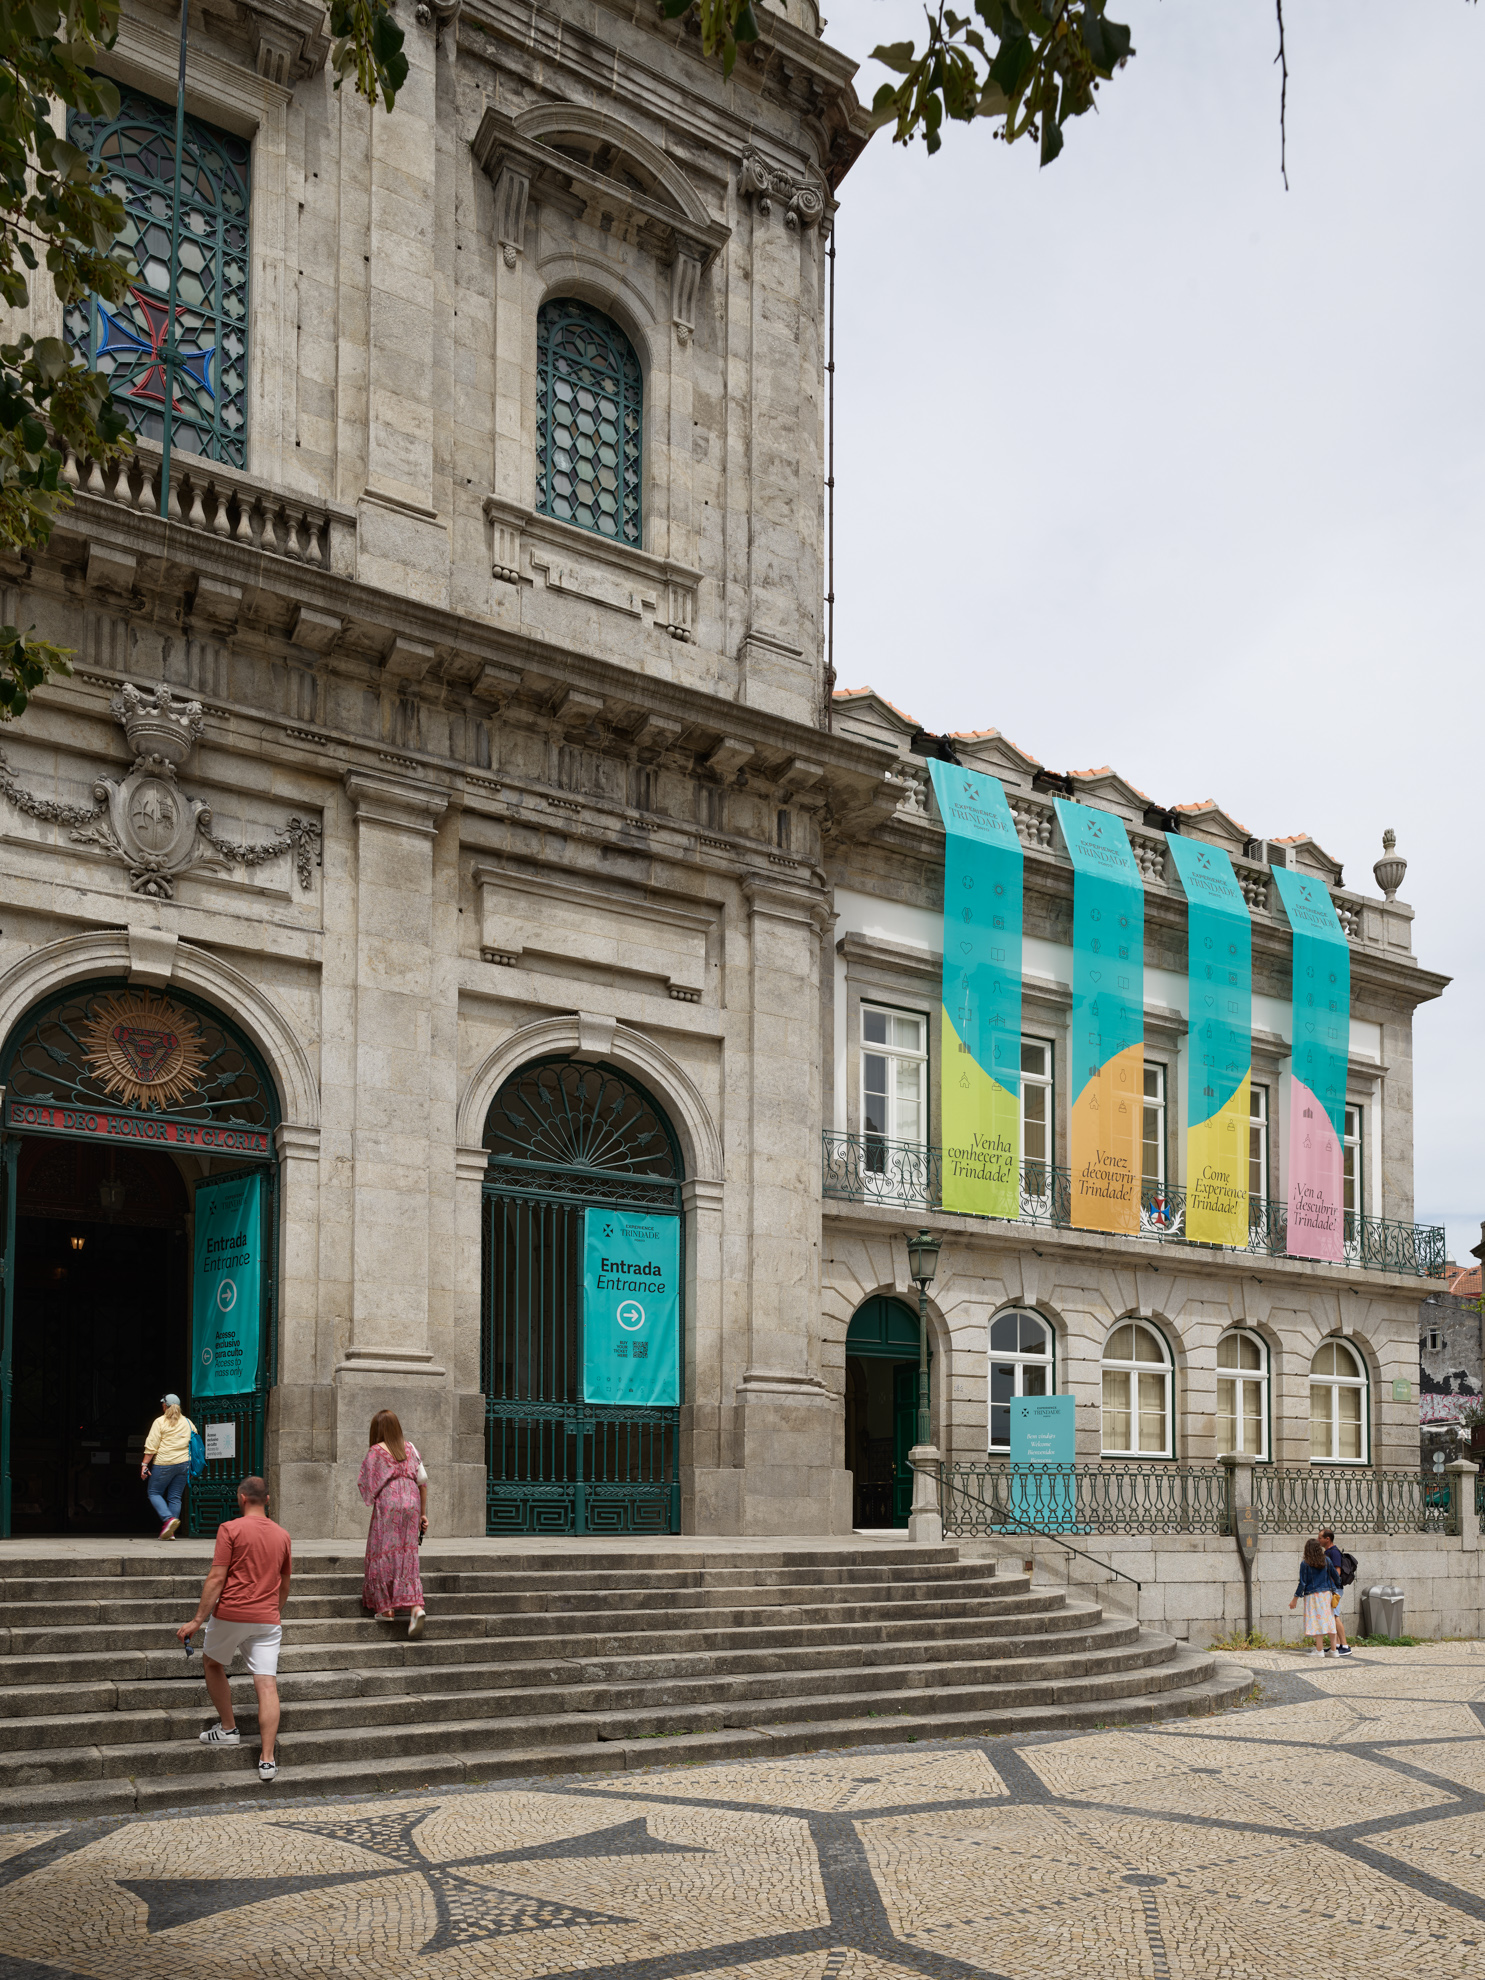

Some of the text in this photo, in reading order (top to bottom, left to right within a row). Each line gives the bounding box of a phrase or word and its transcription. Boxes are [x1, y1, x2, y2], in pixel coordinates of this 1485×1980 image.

[949, 806, 1009, 832] TRINDADE
[954, 802, 998, 819] EXPERIENCE
[974, 824, 990, 832] PORTO
[1075, 844, 1130, 868] TRINDADE
[1080, 840, 1119, 856] EXPERIENCE
[1187, 876, 1237, 898] TRINDADE
[1192, 871, 1228, 886] EXPERIENCE
[1292, 907, 1337, 929] TRINDADE
[1295, 903, 1328, 917] EXPERIENCE
[13, 1106, 263, 1150] SOLI DEO HONOR ET GLORIA
[973, 1133, 1011, 1153] Venha
[948, 1143, 1013, 1166] conhecer a
[1096, 1149, 1128, 1168] Venez
[951, 1160, 1011, 1183] Trindade!
[1082, 1162, 1136, 1184] découvrir
[1203, 1165, 1230, 1183] Come
[1079, 1179, 1132, 1201] Trindade!
[1195, 1178, 1247, 1200] Experience
[1293, 1182, 1323, 1200] ¡Ven a
[1191, 1194, 1238, 1214] Trindade!
[1295, 1196, 1338, 1216] descubrir
[1294, 1211, 1337, 1231] Trindade!
[207, 1231, 247, 1254] Entrada
[620, 1229, 660, 1239] TRINDADE
[203, 1252, 251, 1272] Entrance
[601, 1257, 662, 1276] Entrada
[597, 1274, 666, 1294] Entrance
[215, 1331, 236, 1340] Acesso
[215, 1339, 240, 1349] exclusivo
[215, 1348, 243, 1359] para culto
[215, 1358, 242, 1368] Access to
[215, 1366, 243, 1377] mass only
